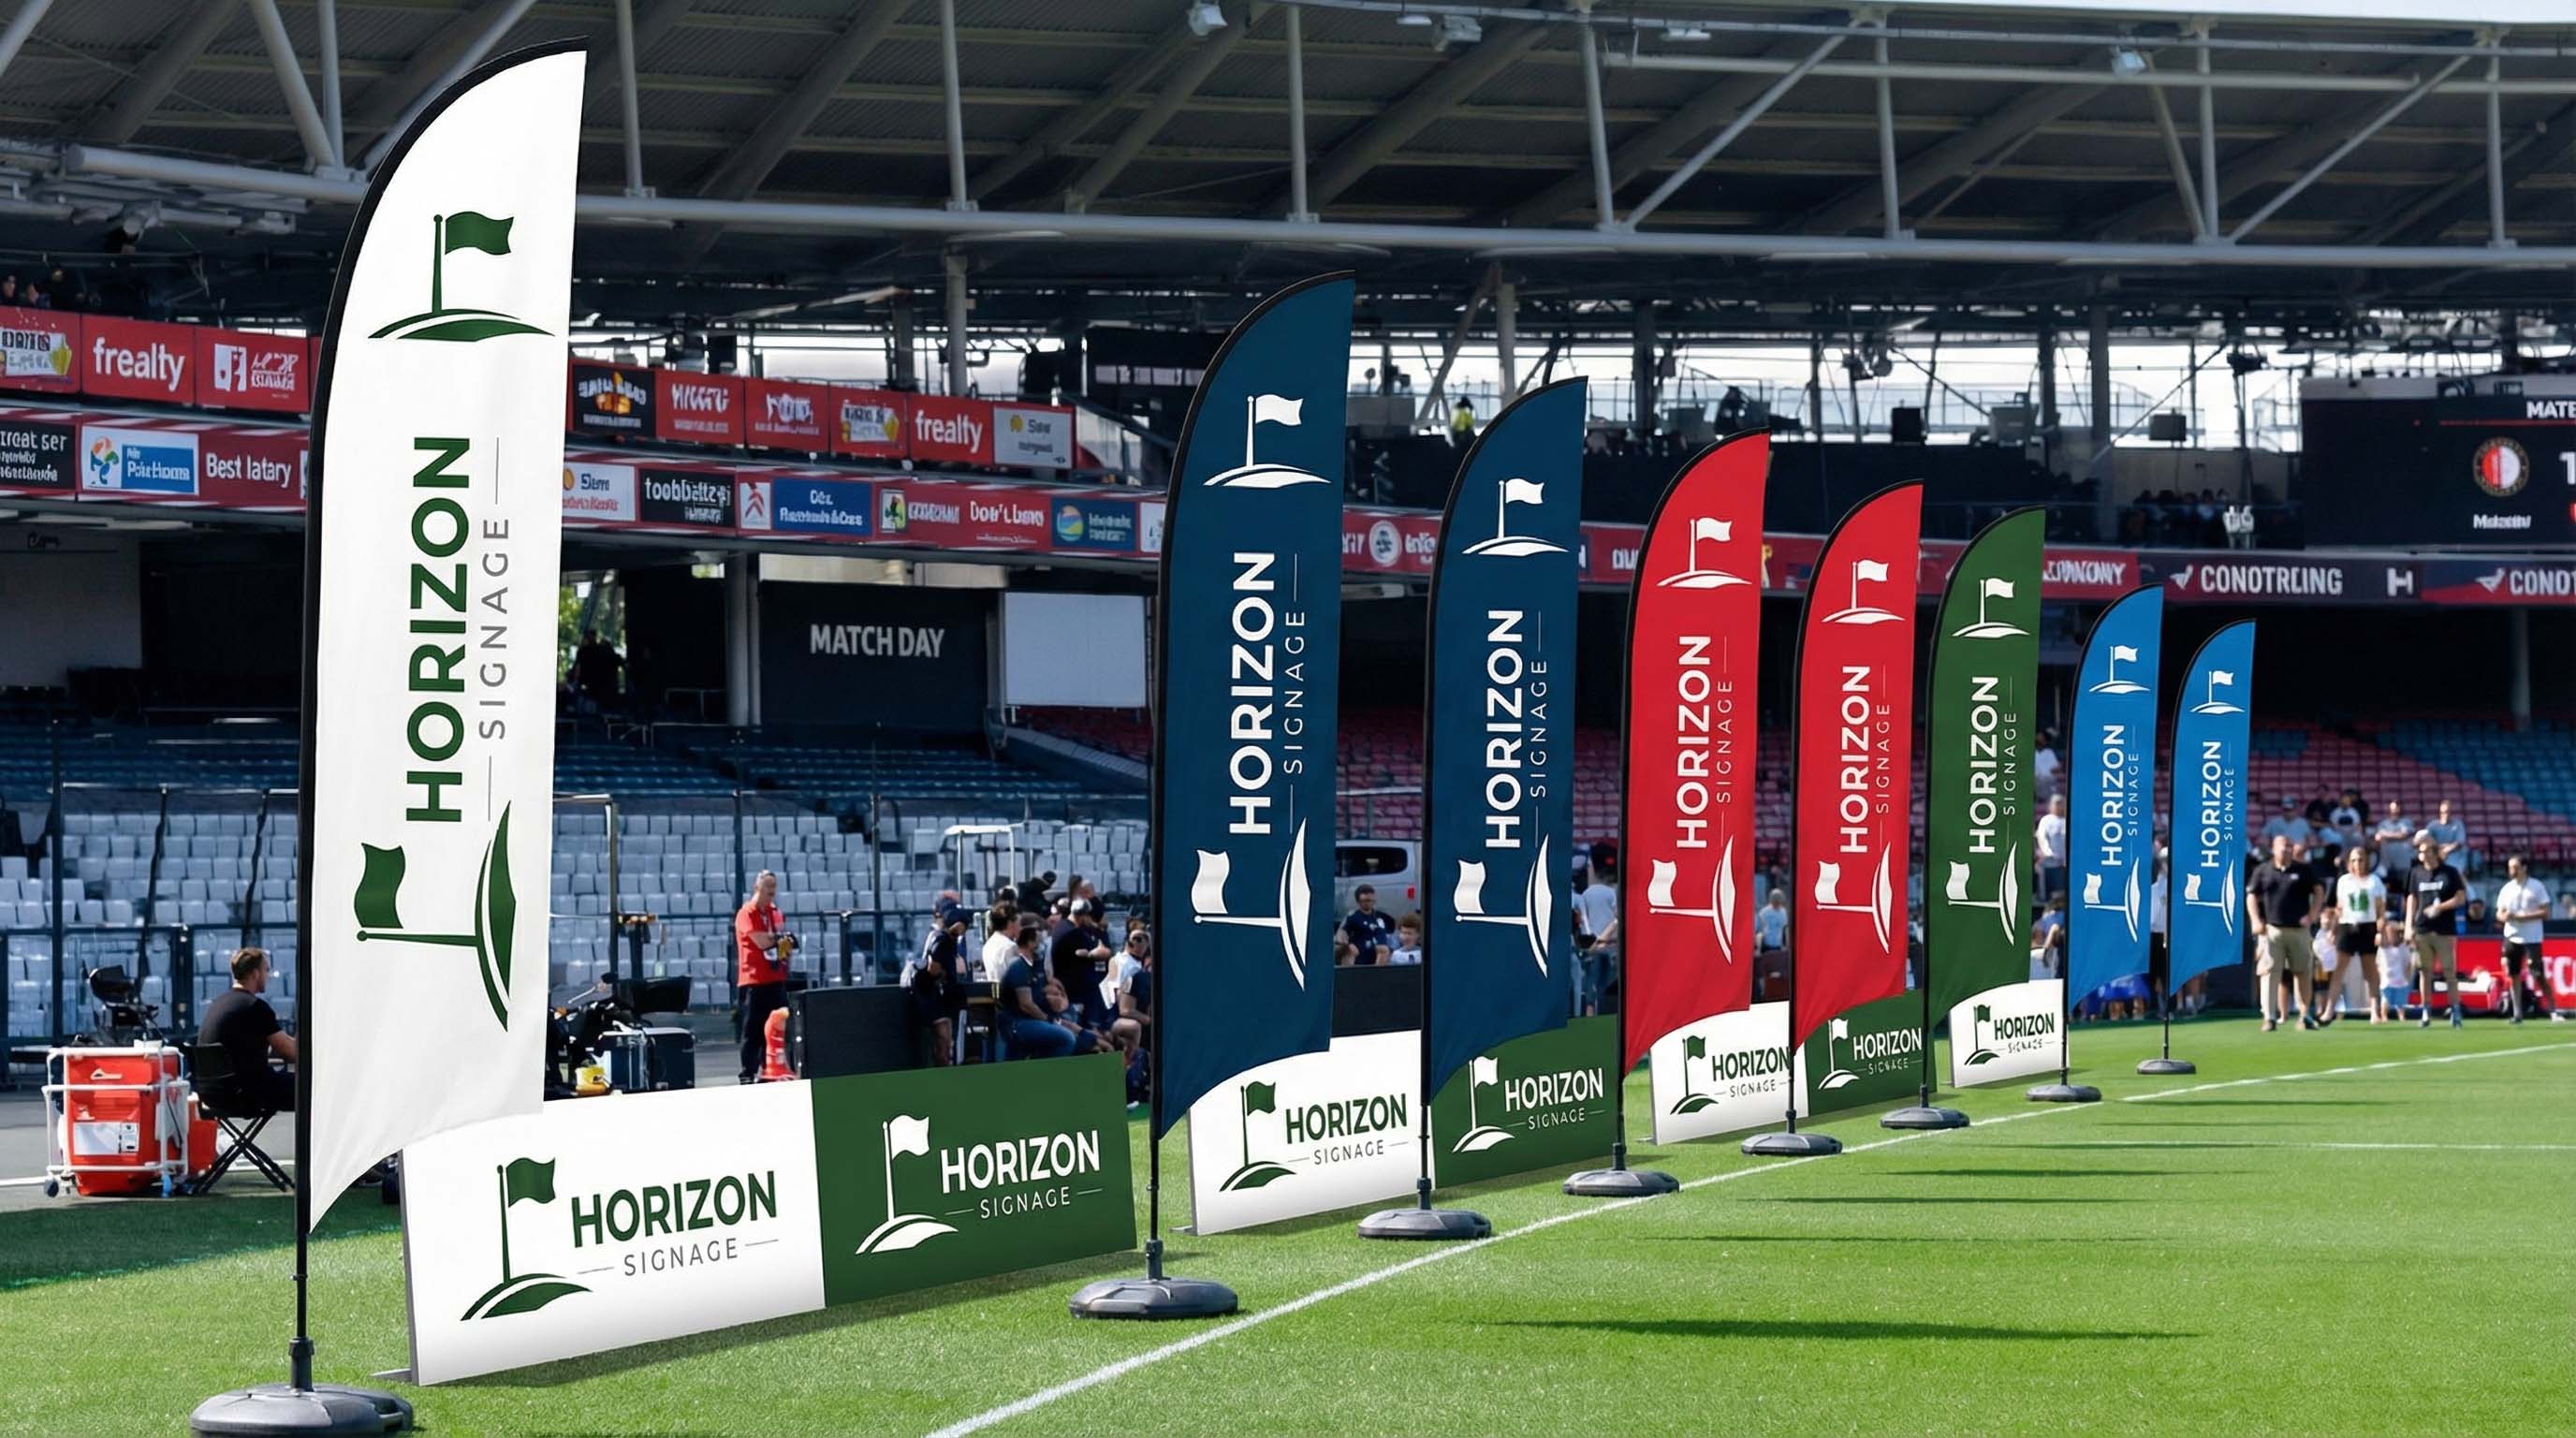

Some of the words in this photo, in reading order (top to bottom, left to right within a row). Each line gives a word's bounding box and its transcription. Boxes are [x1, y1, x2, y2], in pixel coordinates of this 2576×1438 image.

[93, 336, 185, 391] frealty
[205, 452, 242, 479] Best
[915, 409, 983, 453] frealty
[406, 437, 470, 822] HORIZON
[478, 519, 508, 740] SIGNAGE
[810, 624, 894, 656] MATCH
[899, 627, 945, 658] DAY
[1229, 552, 1275, 834] HORIZON
[1283, 611, 1305, 774] SIGNAGE
[1486, 609, 1523, 847] HORIZON
[1530, 661, 1547, 798] SIGNAGE
[1676, 636, 1711, 848] HORIZON
[1717, 681, 1732, 803] SIGNAGE
[1839, 666, 1870, 853] HORIZON
[1876, 705, 1890, 814] SIGNAGE
[1969, 677, 1998, 853] HORIZON
[2003, 713, 2016, 815] SIGNAGE
[2101, 725, 2125, 866] HORIZON
[2201, 741, 2221, 867] HORIZON
[1712, 1046, 1790, 1082] HORIZON
[1853, 1027, 1922, 1061] HORIZON
[1994, 1012, 2055, 1041] HORIZON
[1285, 1093, 1408, 1145] HORIZON
[1504, 1067, 1604, 1113] HORIZON
[1528, 1107, 1586, 1130] SIGNAGE
[940, 1129, 1102, 1195] HORIZON
[1314, 1139, 1384, 1166] SIGNAGE
[570, 1169, 778, 1250] HORIZON
[979, 1185, 1071, 1219] SIGNAGE
[624, 1237, 739, 1277] SIGNAGE
